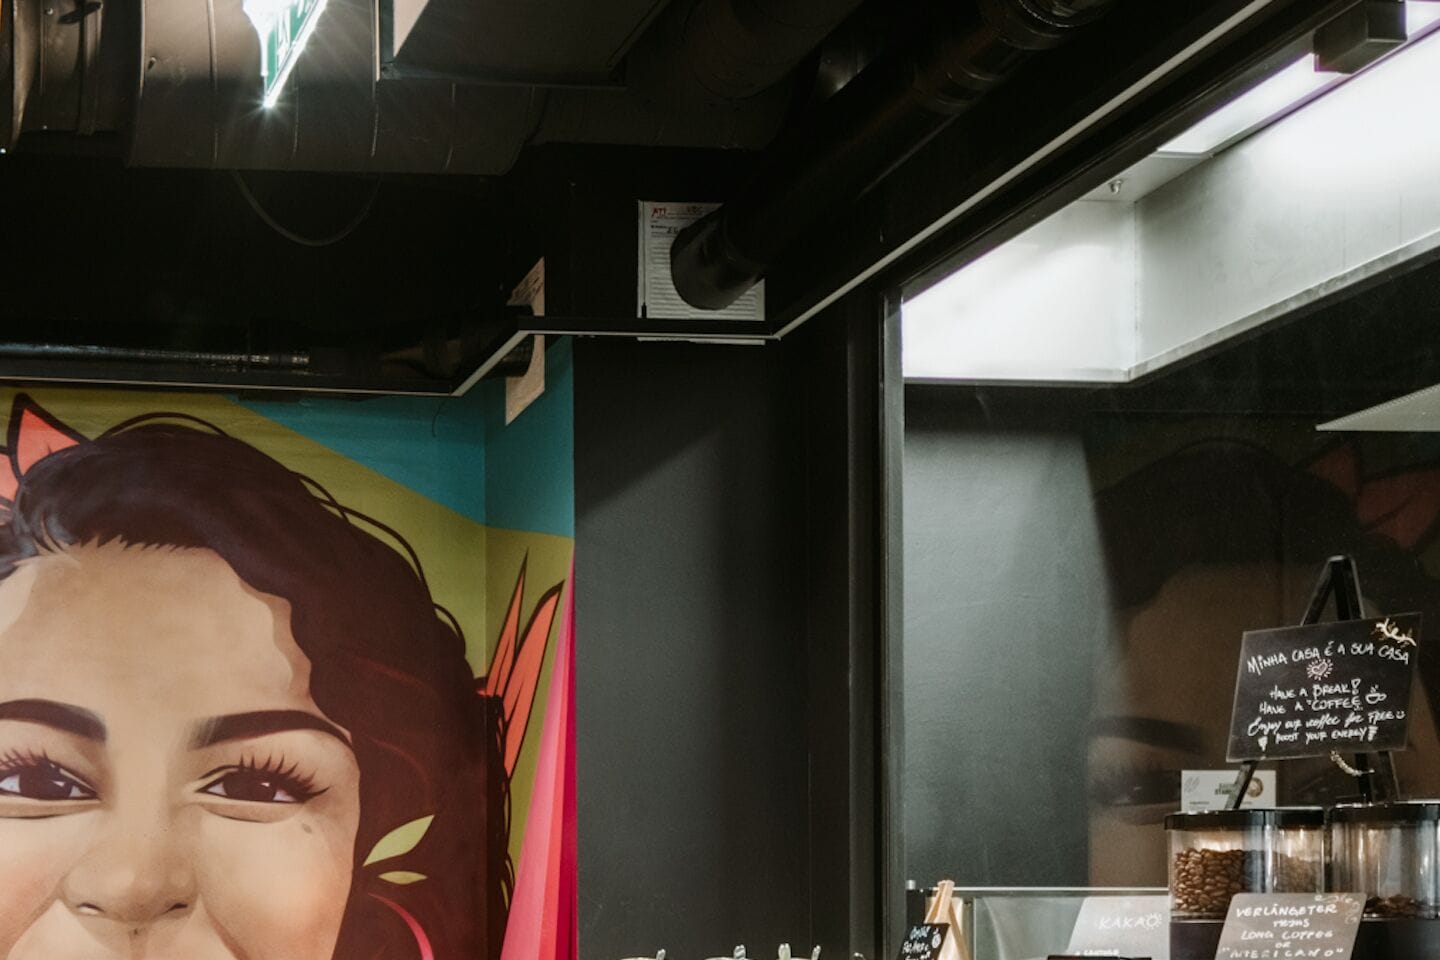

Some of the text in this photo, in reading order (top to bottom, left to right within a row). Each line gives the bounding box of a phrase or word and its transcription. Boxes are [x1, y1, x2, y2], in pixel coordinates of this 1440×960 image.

[1291, 647, 1320, 662] CASA
[1324, 640, 1335, 656] É
[1337, 643, 1346, 655] A
[1350, 642, 1375, 655] SUA
[1378, 645, 1409, 664] CASA
[1269, 685, 1296, 700] HAVE
[1298, 687, 1308, 697] A
[1259, 701, 1286, 715] HAVE
[1294, 701, 1304, 711] A
[1247, 717, 1282, 737] Enjoy
[1305, 713, 1340, 730] coffee
[1344, 712, 1365, 728] for
[1241, 930, 1333, 941] LONG COFFEE
[1275, 941, 1291, 949] OR
